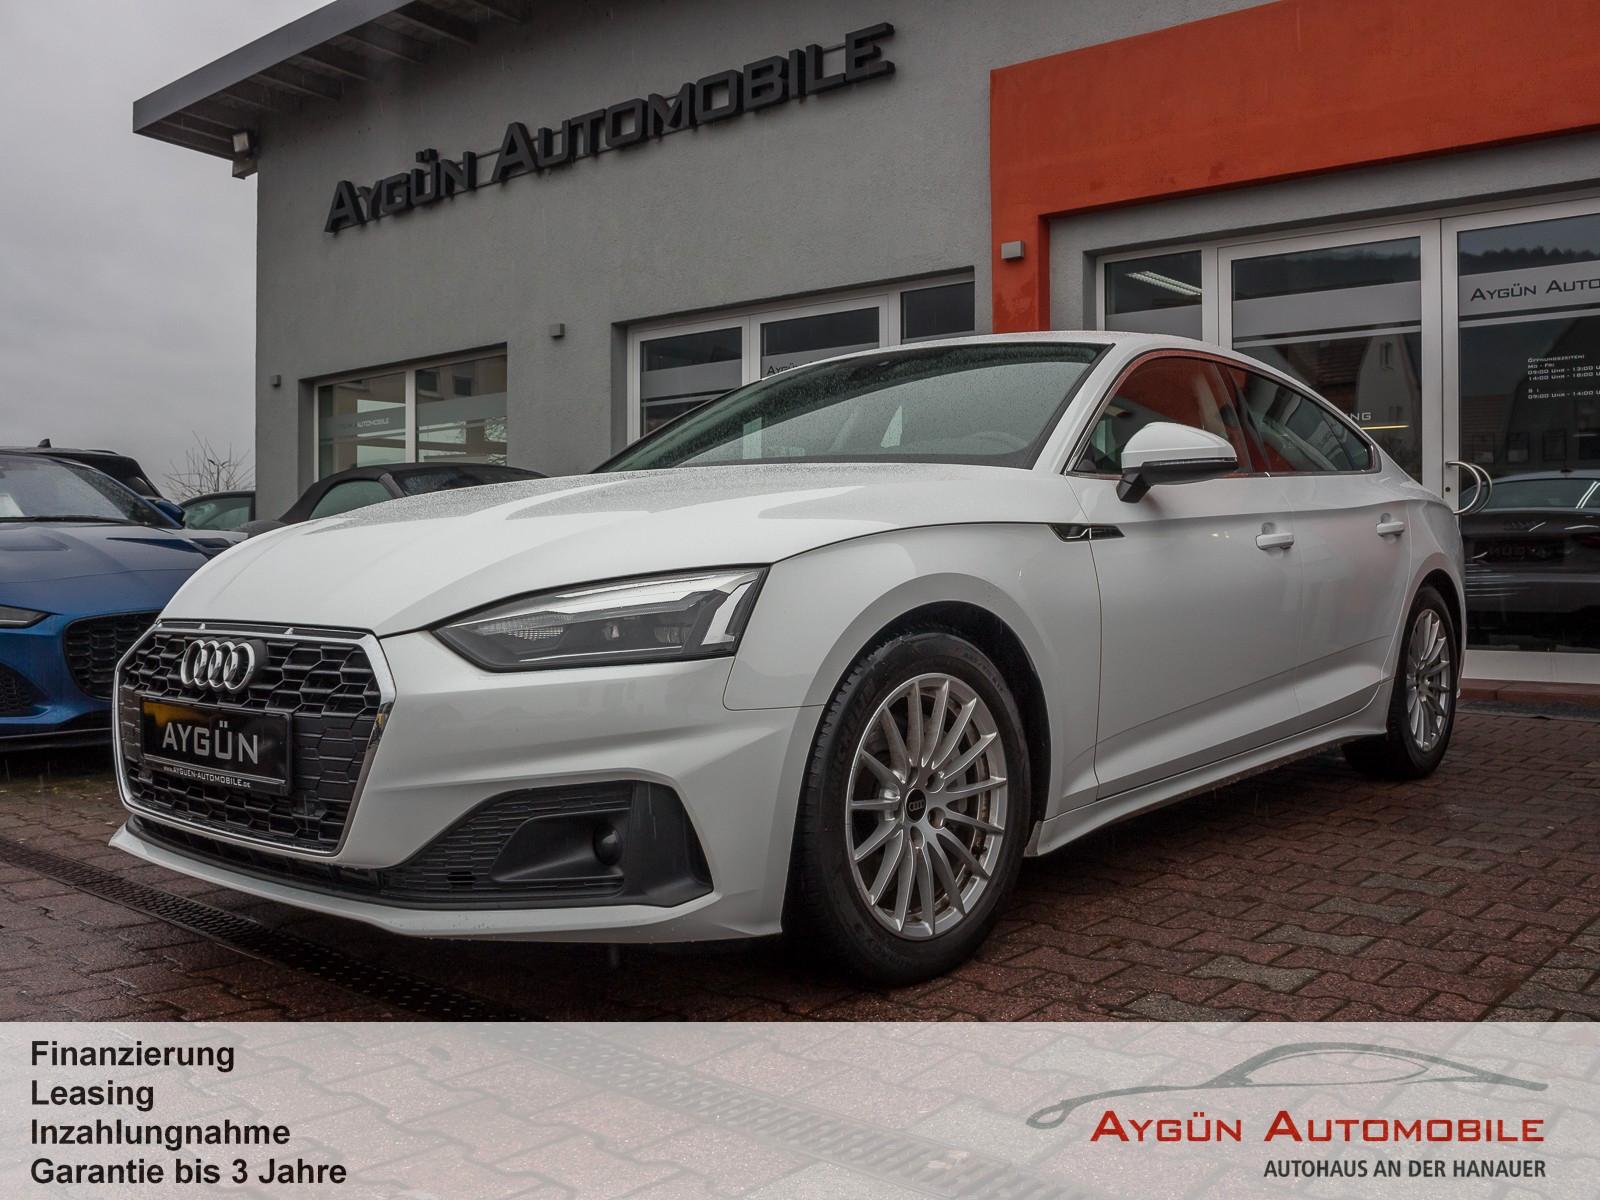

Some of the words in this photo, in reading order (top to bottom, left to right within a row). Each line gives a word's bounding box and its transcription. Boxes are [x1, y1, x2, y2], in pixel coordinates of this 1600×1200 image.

[324, 148, 477, 235] AYGÜN
[491, 22, 896, 183] AUTOMOBILE
[1470, 282, 1537, 302] AYGÜN
[161, 720, 259, 765] AYGÜN
